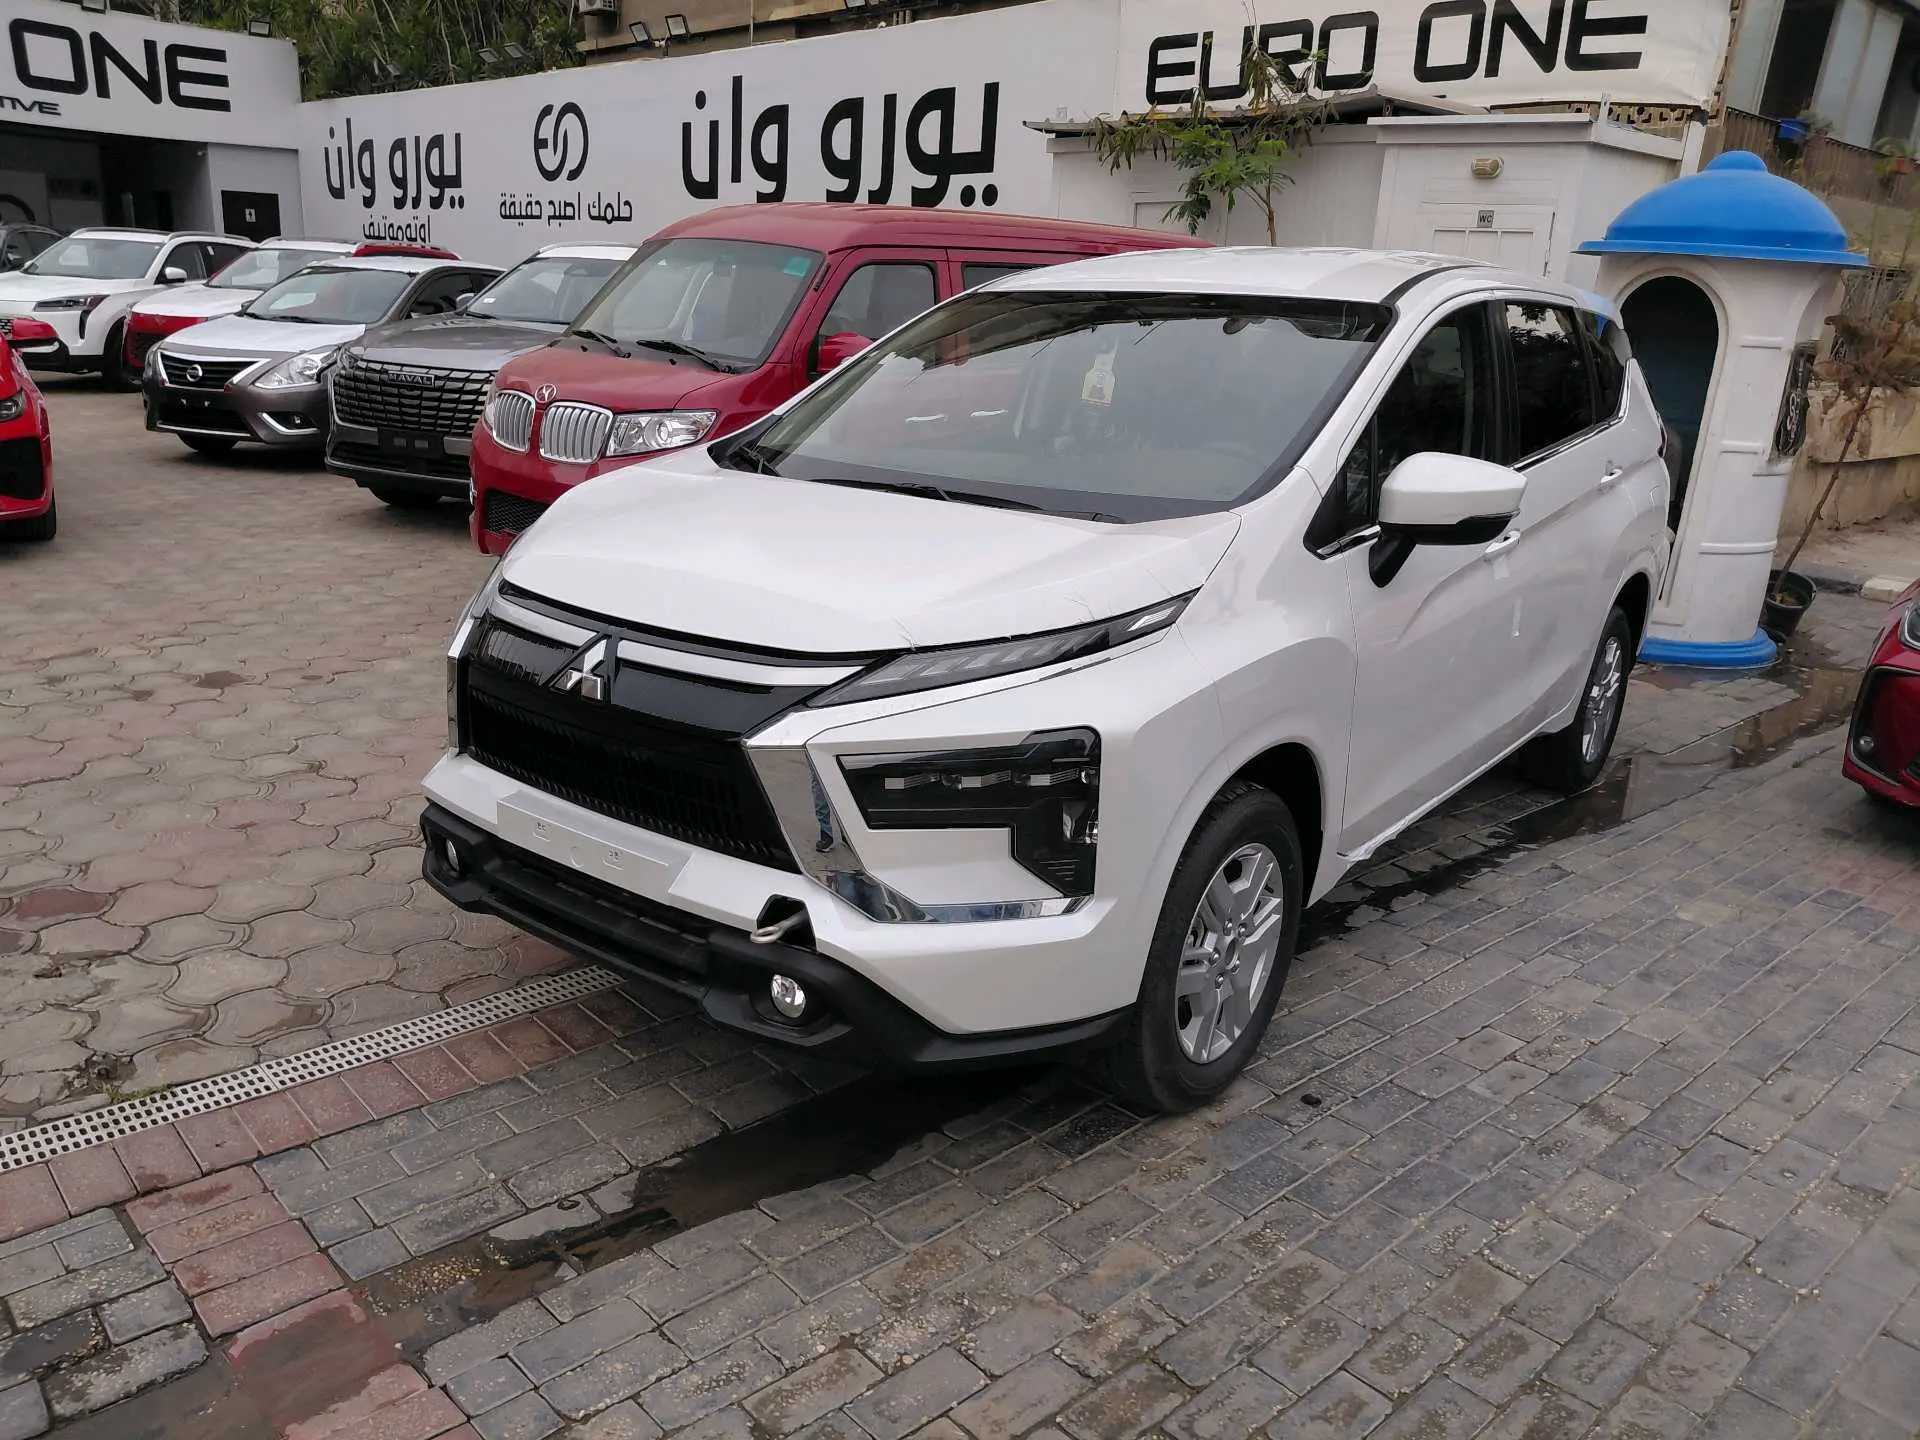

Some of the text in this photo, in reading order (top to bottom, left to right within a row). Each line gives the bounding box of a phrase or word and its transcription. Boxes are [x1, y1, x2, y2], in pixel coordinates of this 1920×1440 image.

[9, 18, 232, 112] ONE
[1146, 0, 1649, 106] EURO ONE
[324, 117, 465, 210] يورو وان
[682, 75, 1000, 208] يورو وان
[499, 191, 633, 228] حلمك اصبح حقيقة
[1479, 214, 1493, 223] WC
